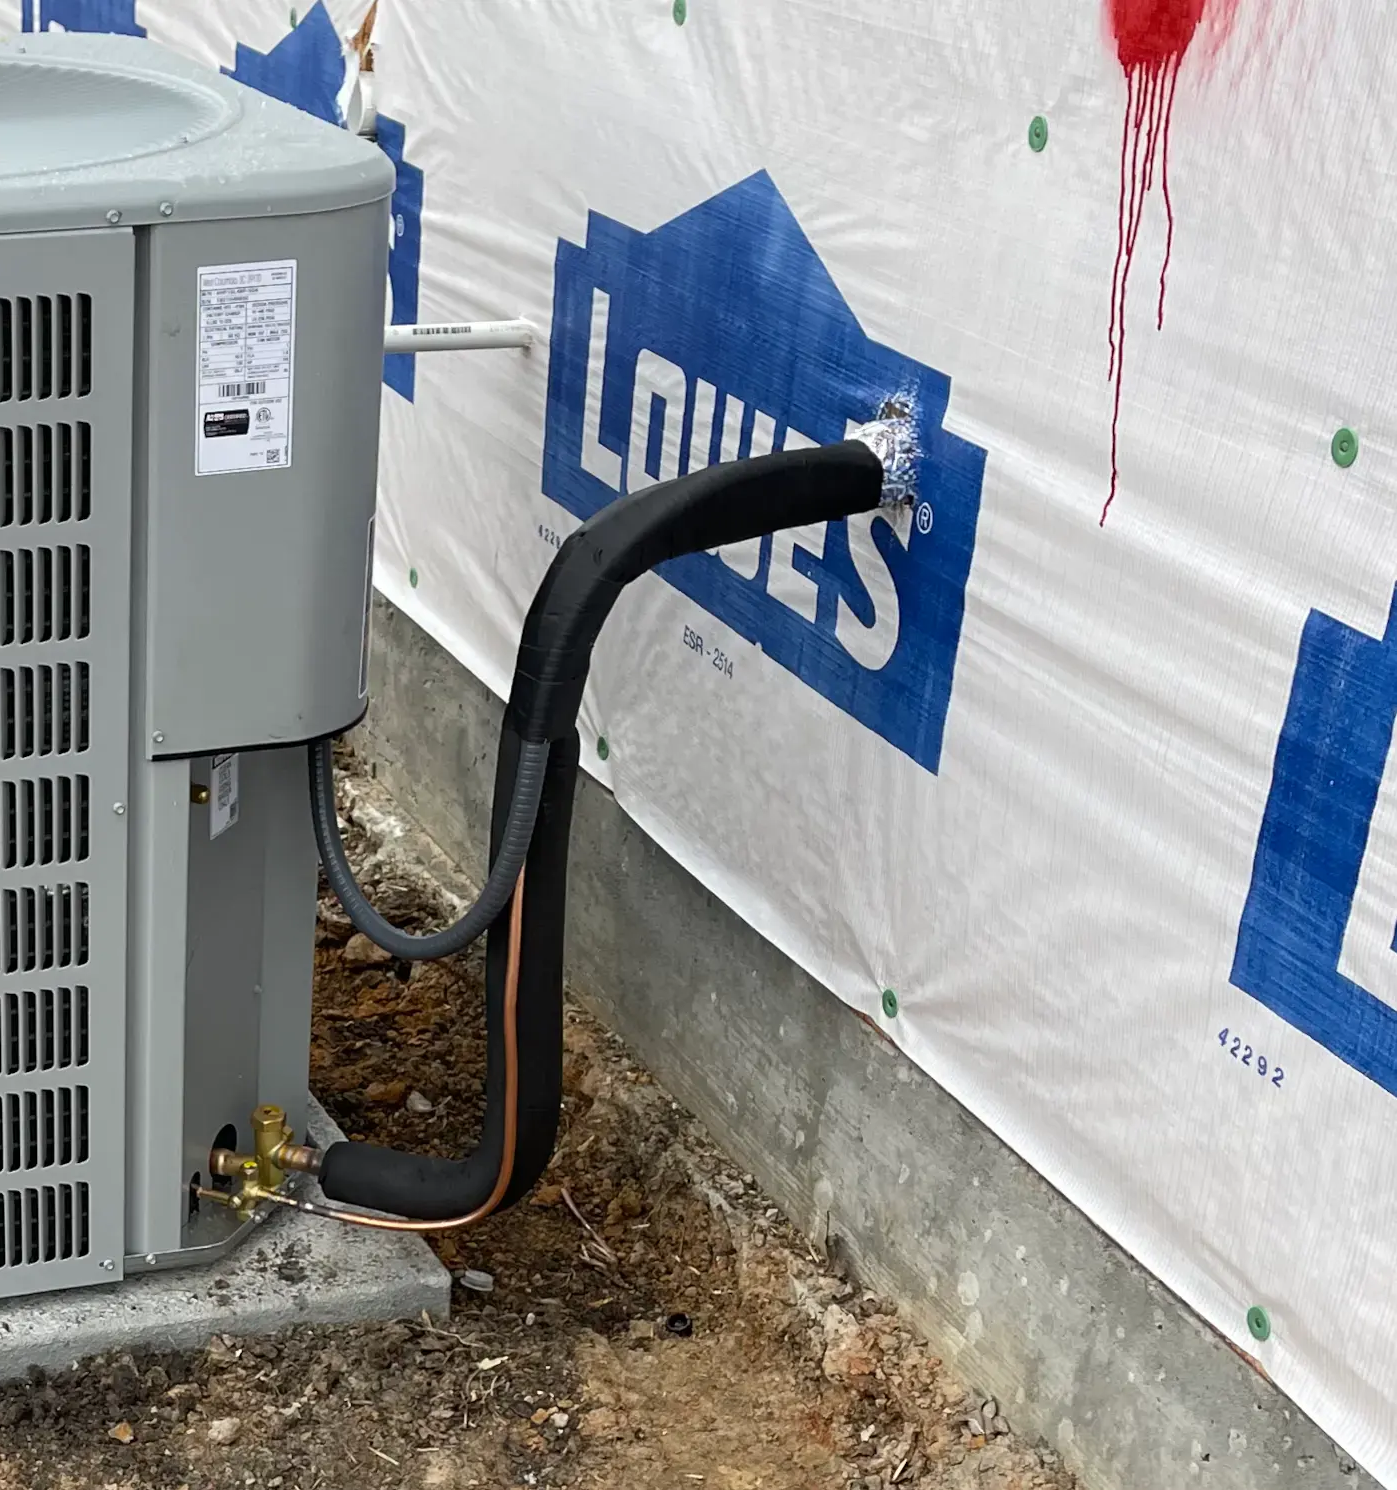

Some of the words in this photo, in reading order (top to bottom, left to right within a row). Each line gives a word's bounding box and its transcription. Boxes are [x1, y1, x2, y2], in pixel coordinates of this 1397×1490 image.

[683, 624, 703, 656] ESR
[712, 647, 734, 680] 2514
[1218, 1027, 1285, 1088] 42292
